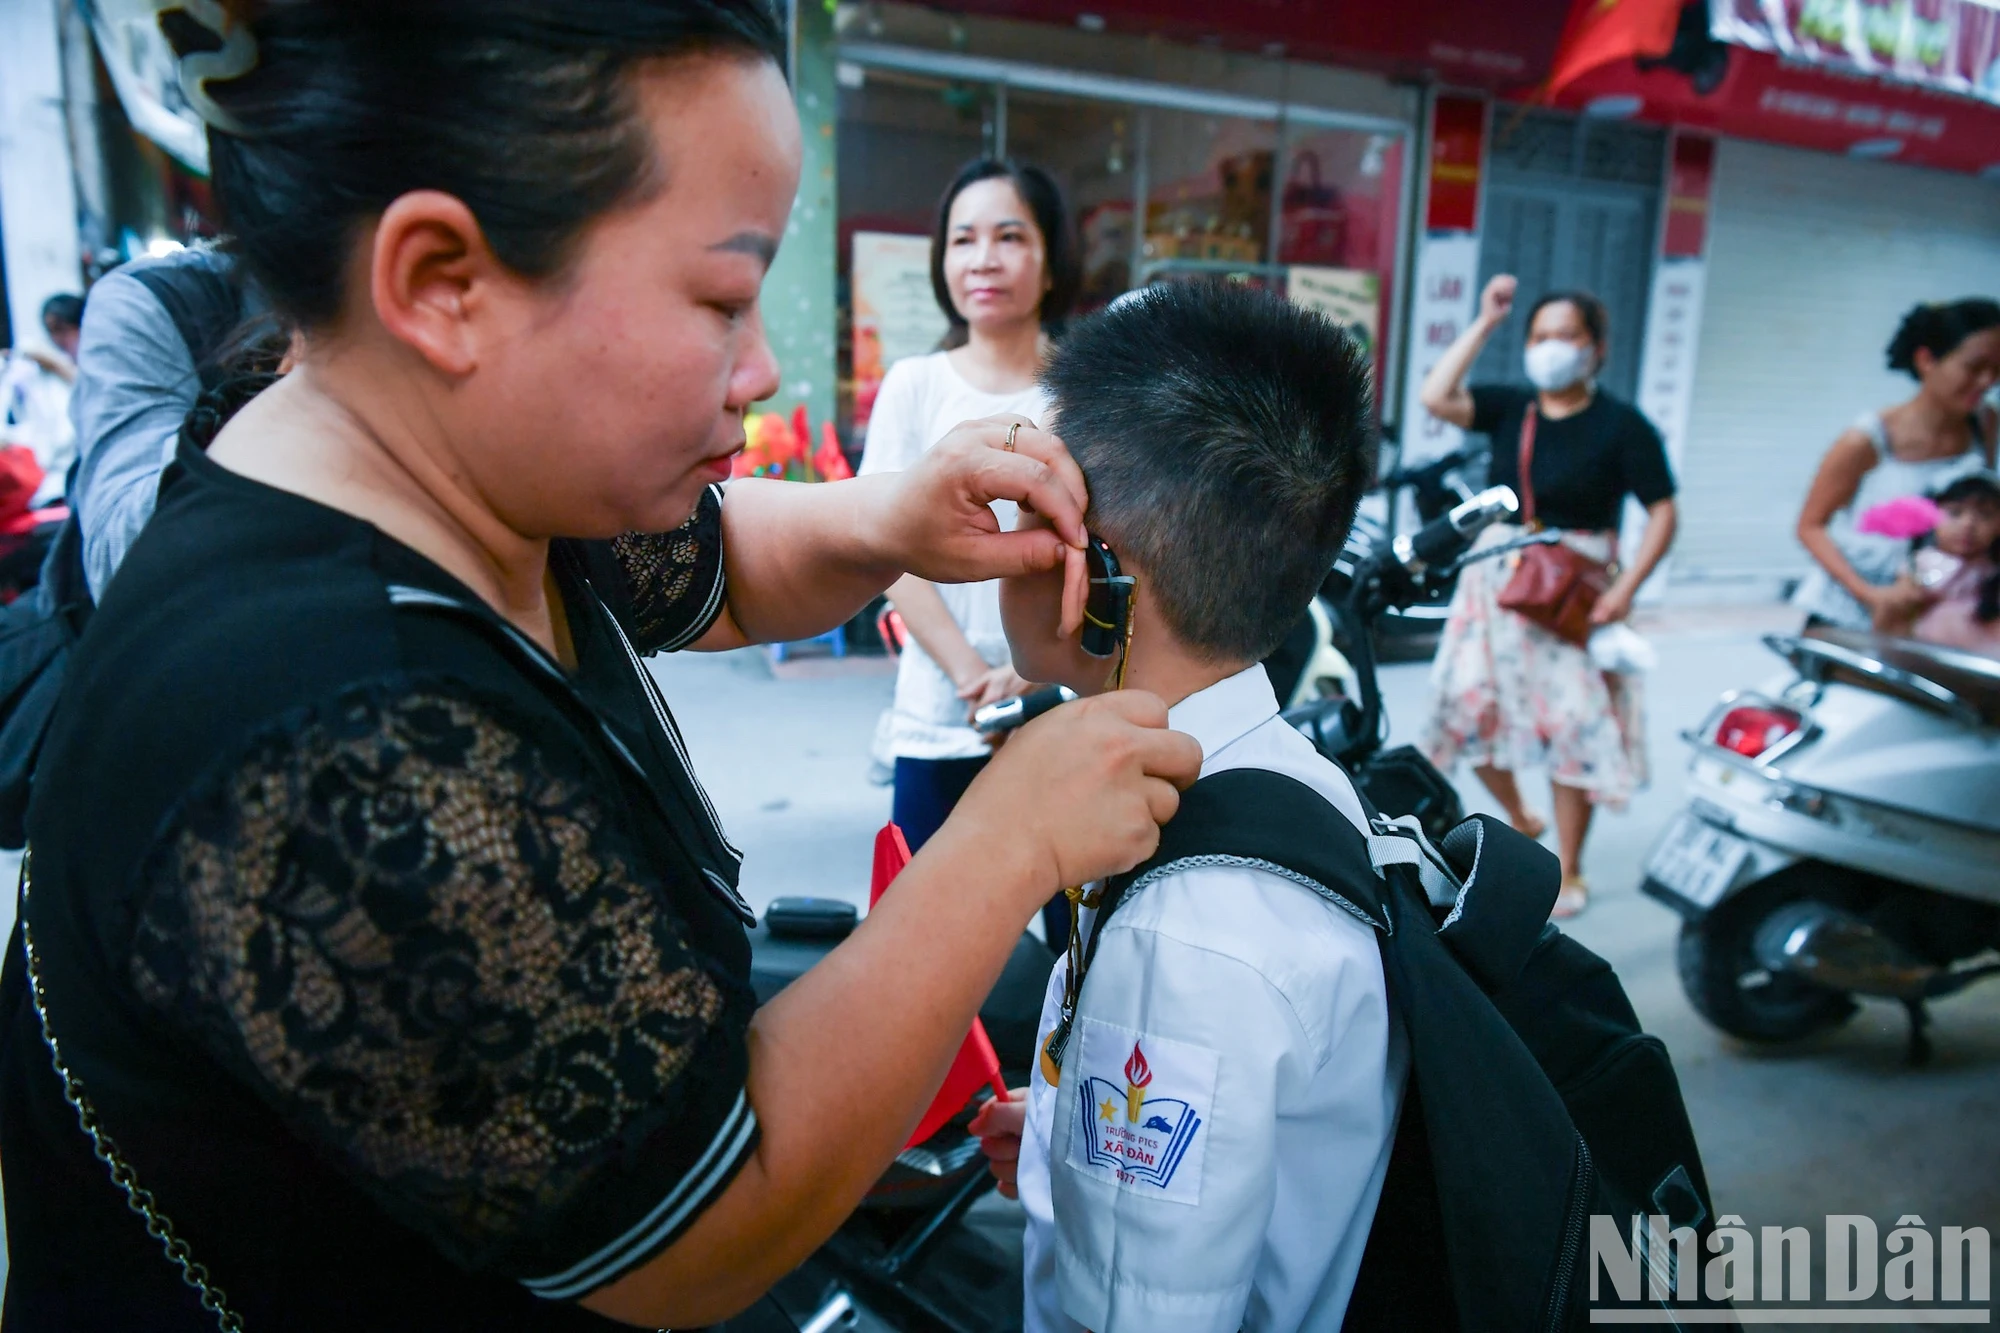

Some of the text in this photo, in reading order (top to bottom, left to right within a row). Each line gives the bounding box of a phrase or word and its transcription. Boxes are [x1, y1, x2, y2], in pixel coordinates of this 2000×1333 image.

[1103, 1140, 1154, 1166] XÃ ĐÀN
[1115, 1169, 1136, 1185] 1977
